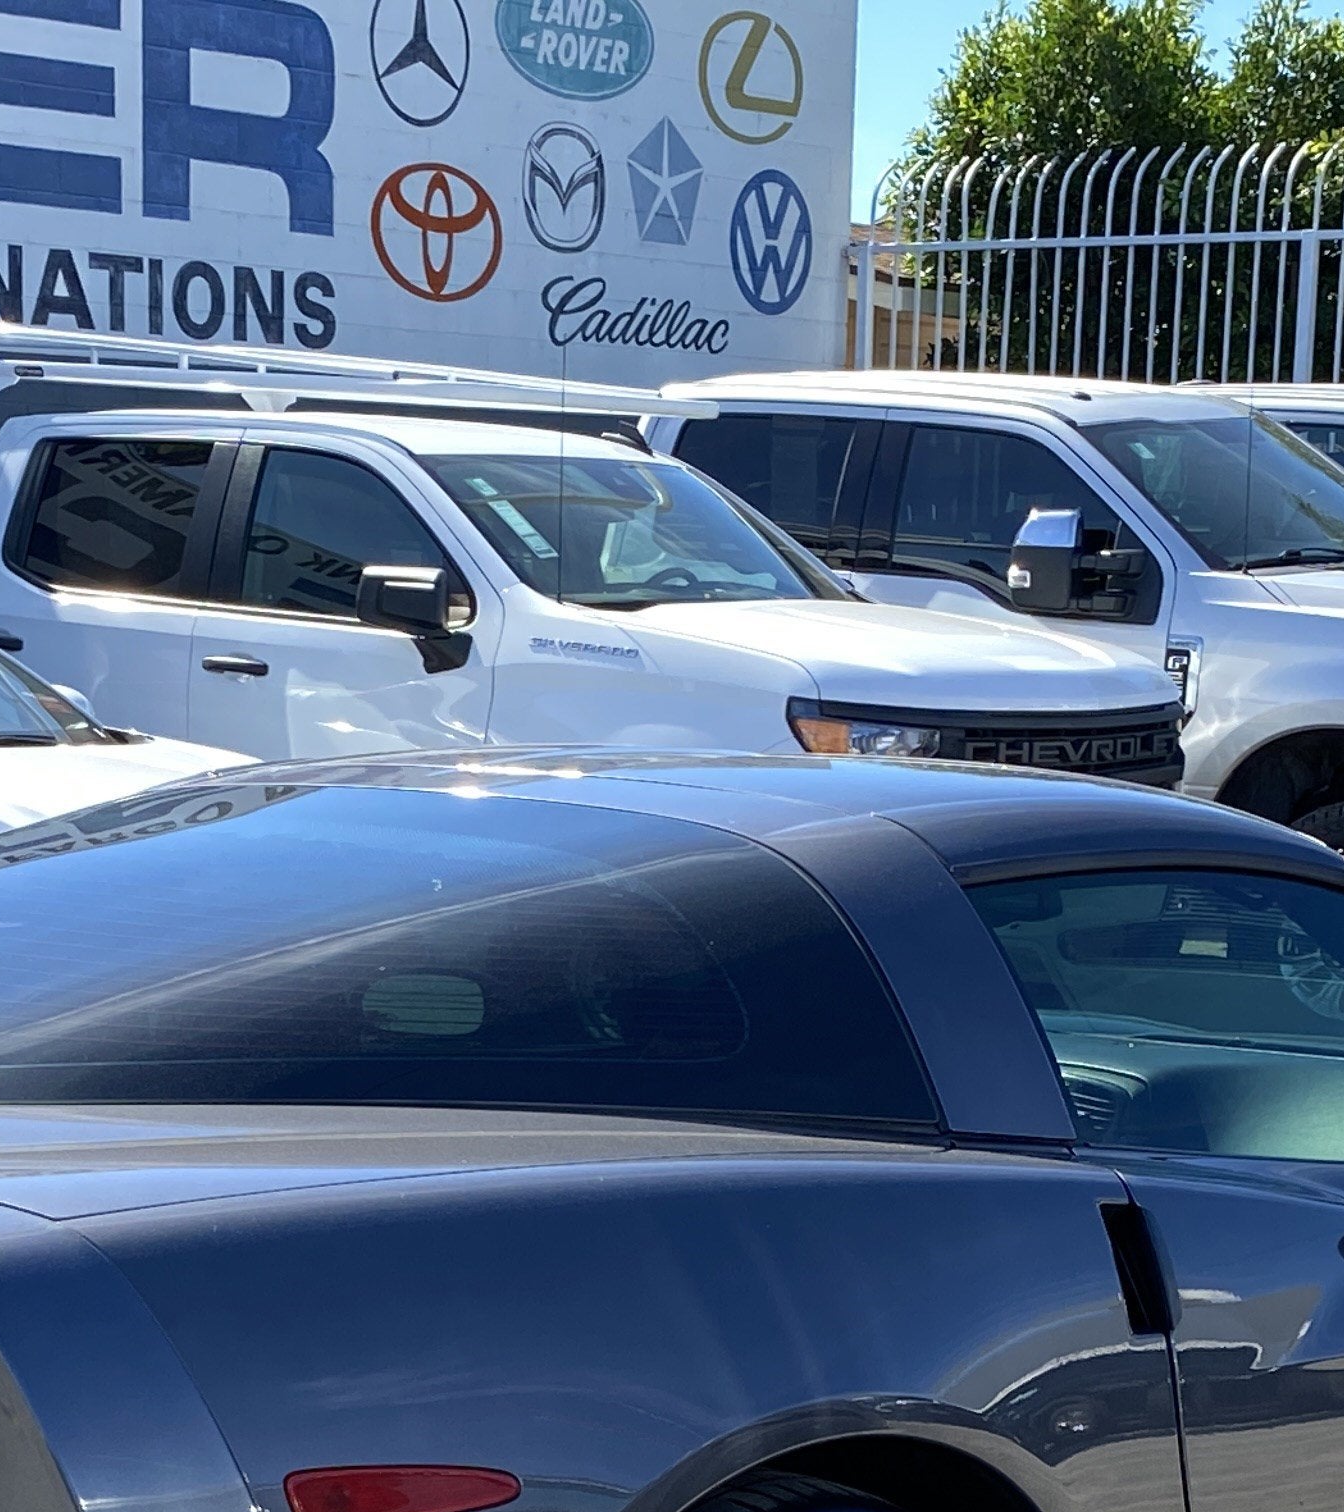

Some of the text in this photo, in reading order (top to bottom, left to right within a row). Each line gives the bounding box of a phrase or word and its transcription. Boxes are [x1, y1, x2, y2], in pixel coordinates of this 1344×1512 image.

[528, 0, 606, 30] LAND
[537, 29, 631, 75] ROVER
[541, 275, 730, 355] Cadillac
